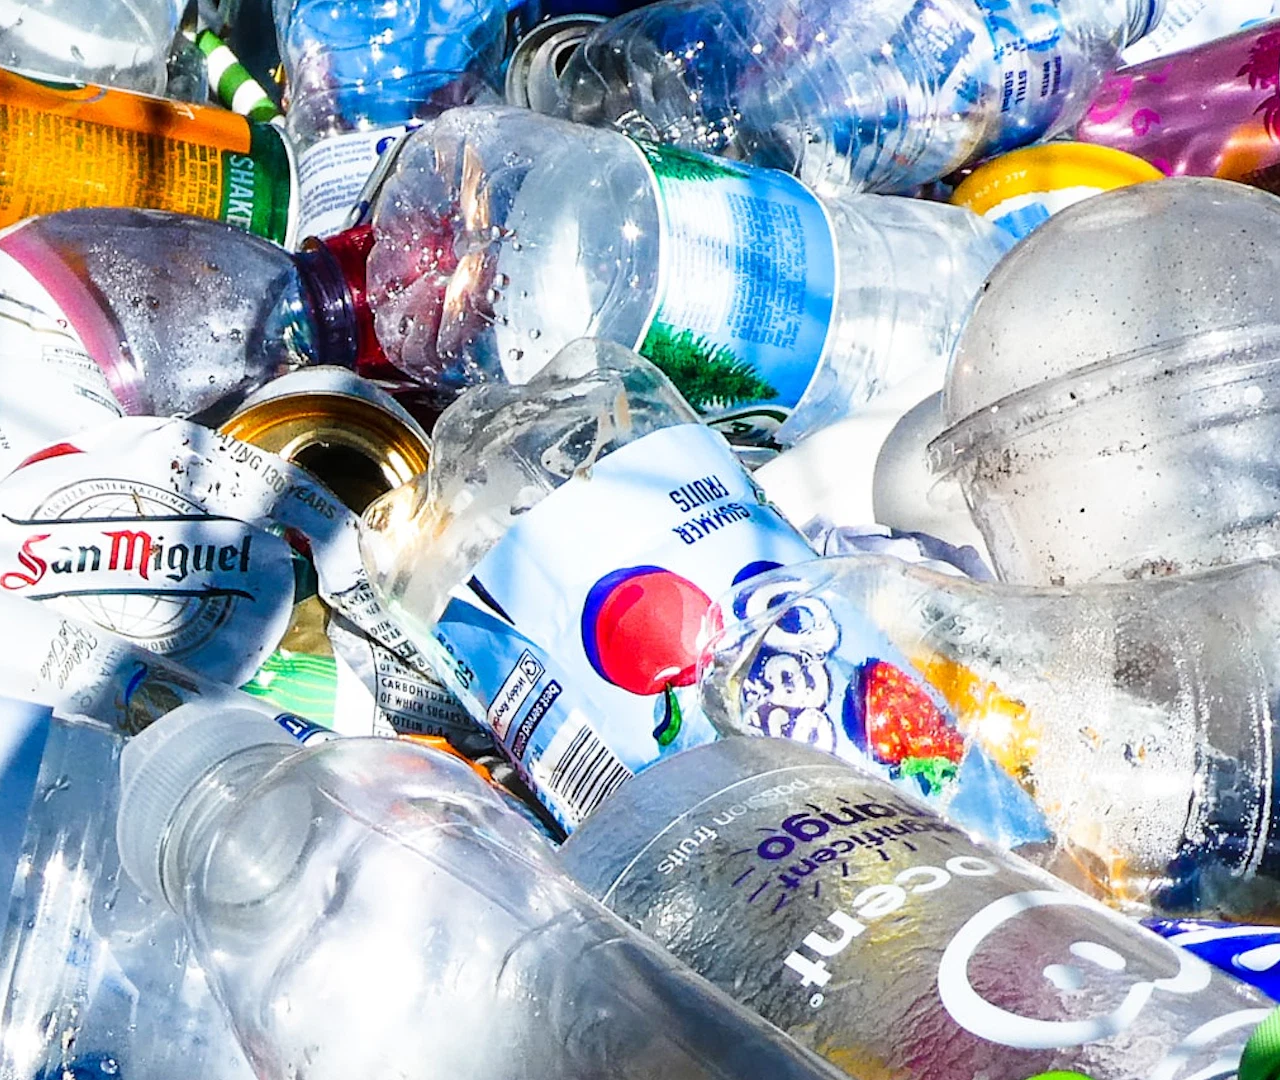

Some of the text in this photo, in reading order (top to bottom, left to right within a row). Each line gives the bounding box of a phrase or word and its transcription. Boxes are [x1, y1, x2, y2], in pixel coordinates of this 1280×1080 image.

[1014, 70, 1027, 104] STILL
[261, 464, 338, 520] 130 YEARS
[668, 474, 731, 513] FRUITS
[671, 502, 751, 546] SUMMER
[380, 692, 424, 714] OF WHICH
[656, 776, 810, 877] passion fruits
